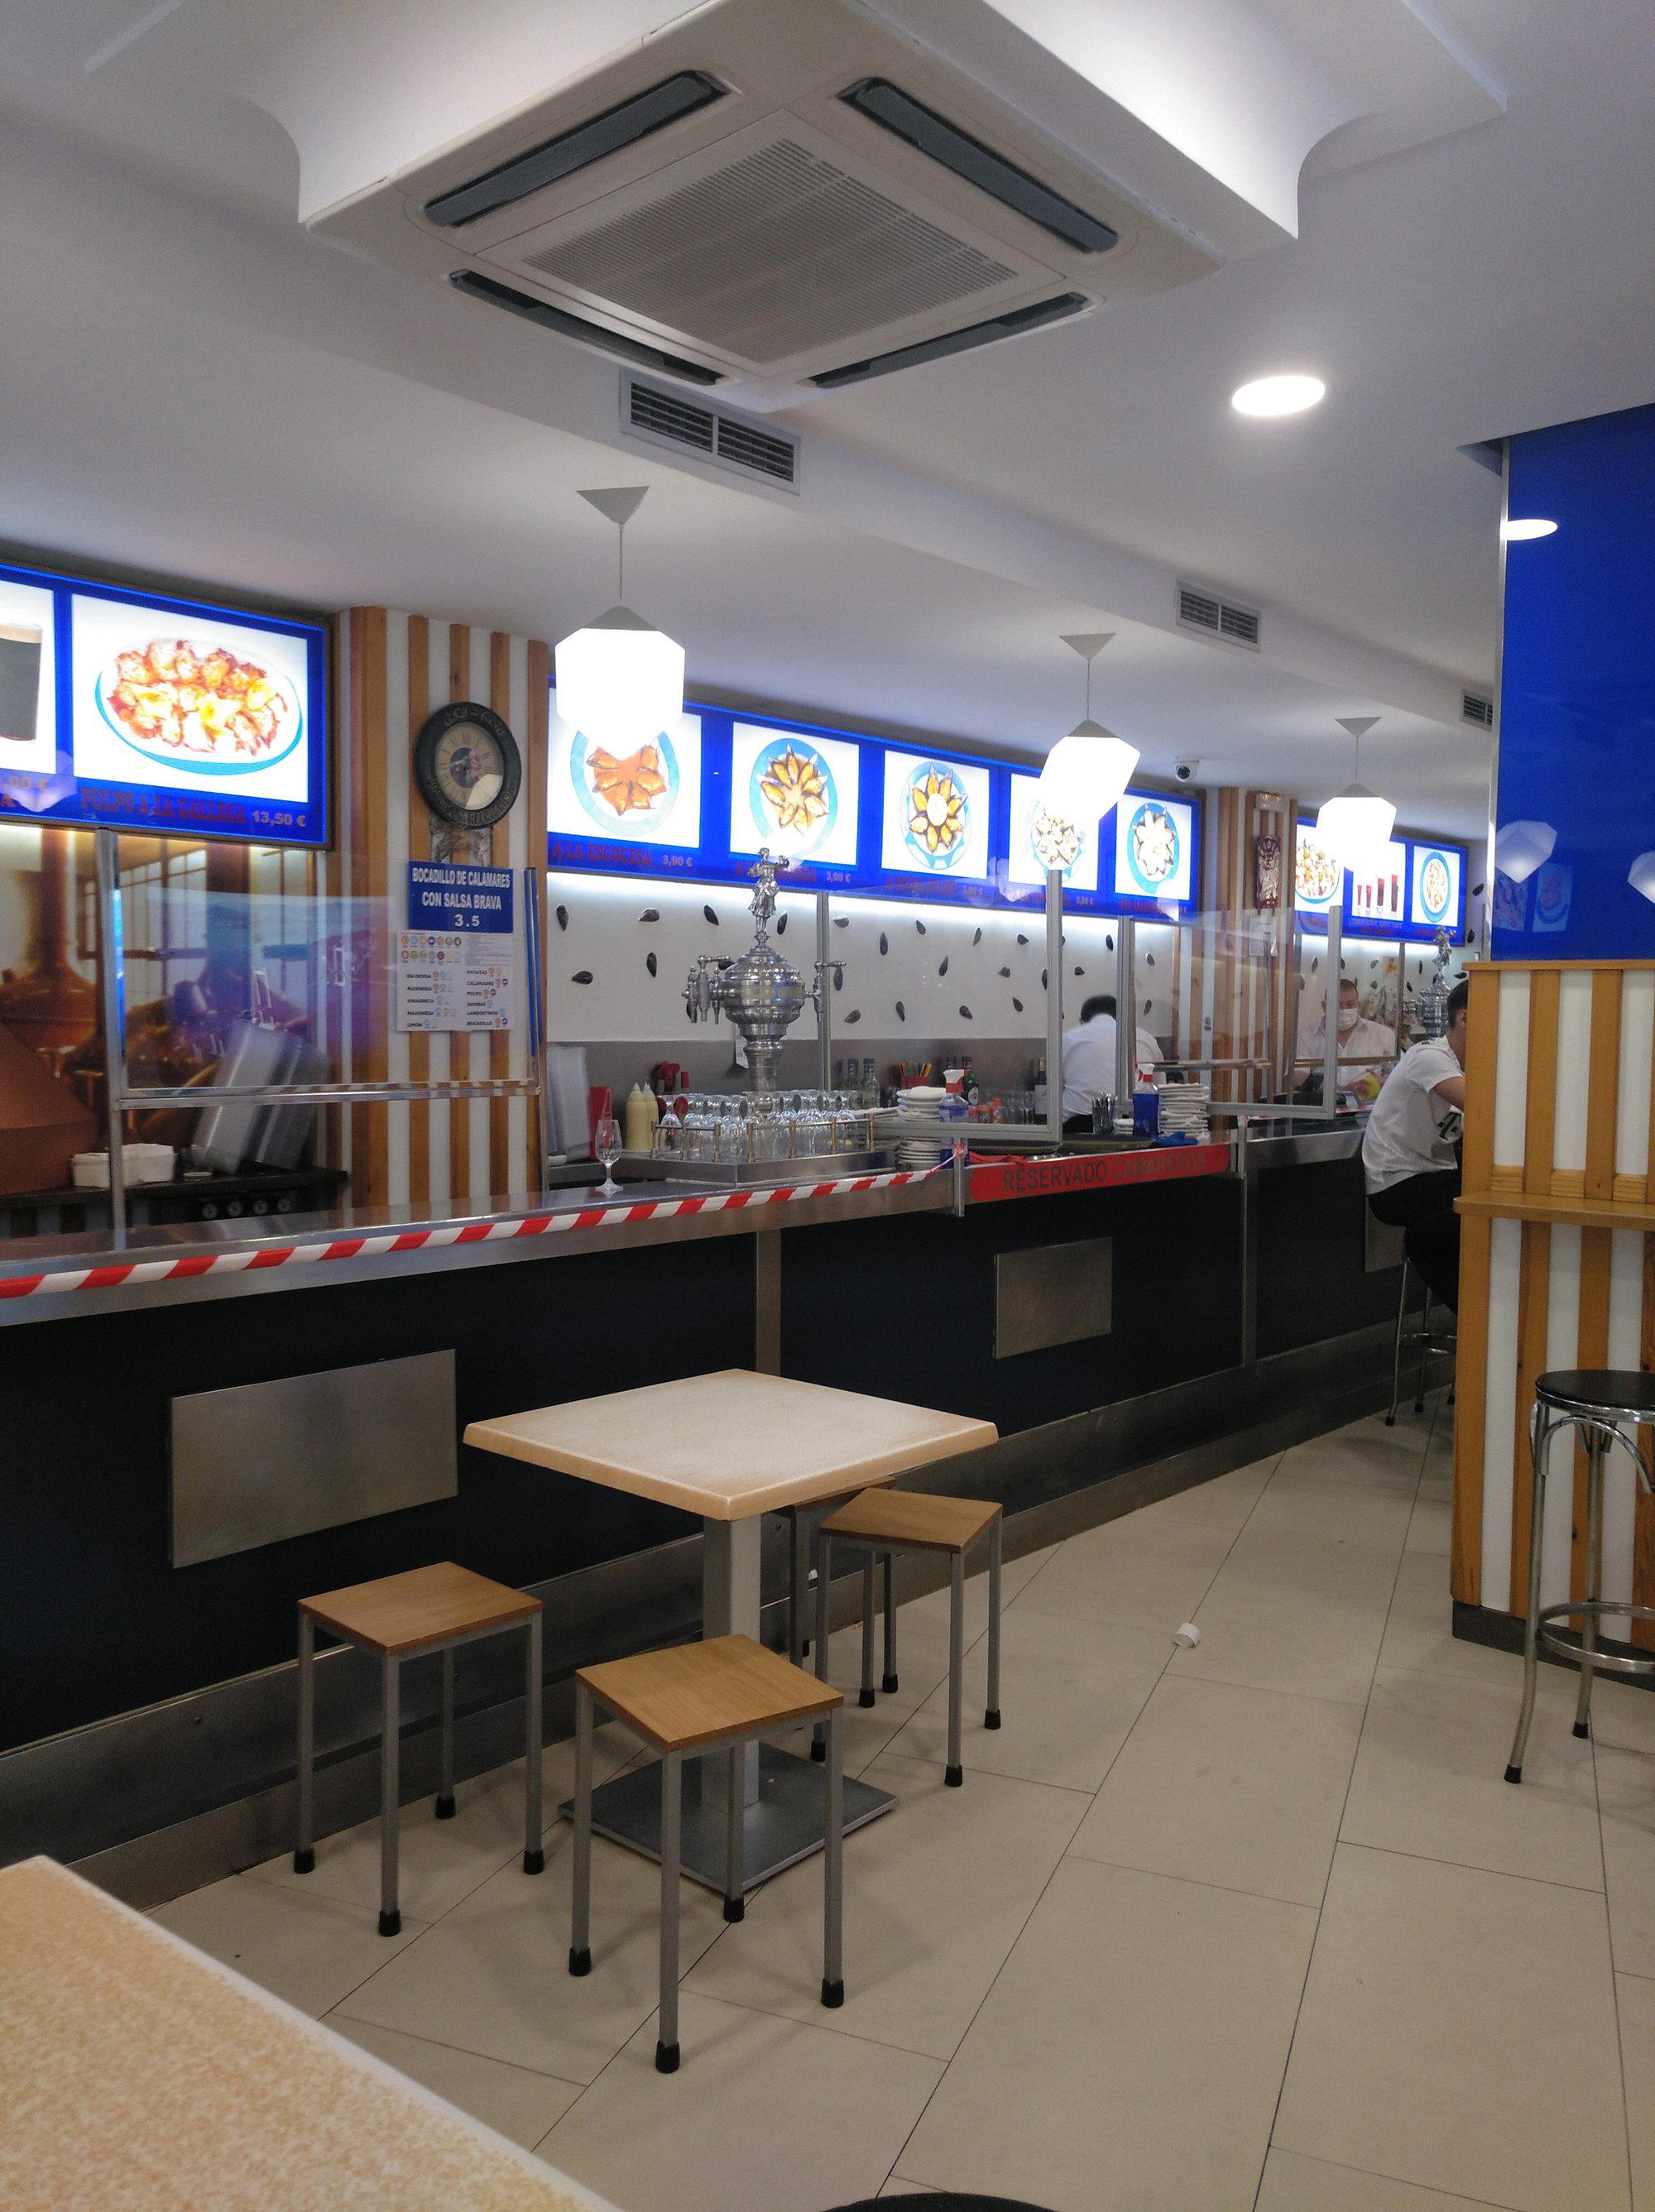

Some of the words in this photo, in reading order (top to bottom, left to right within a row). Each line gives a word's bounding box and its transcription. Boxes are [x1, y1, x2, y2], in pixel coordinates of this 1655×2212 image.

[81, 789, 134, 812] PULPO
[140, 794, 148, 814] A
[155, 794, 174, 818] LA
[178, 799, 247, 823] GALLEGA
[252, 811, 293, 826] 13,50
[297, 815, 306, 827] €
[553, 839, 562, 858] A
[566, 841, 584, 861] LA
[588, 844, 652, 866] ESCOCESA
[663, 855, 684, 867] 3,90
[684, 857, 693, 867] €
[412, 867, 455, 885] BOCADILLO
[457, 871, 467, 885] DE
[468, 871, 511, 888] CALAMARES
[422, 891, 442, 907] CON
[444, 893, 472, 909] SALSA
[473, 895, 501, 910] BRAVA
[454, 914, 480, 927] 3.5
[1002, 1161, 1107, 1192] RESERVADO
[1112, 1151, 1206, 1180] CAMAREROS
